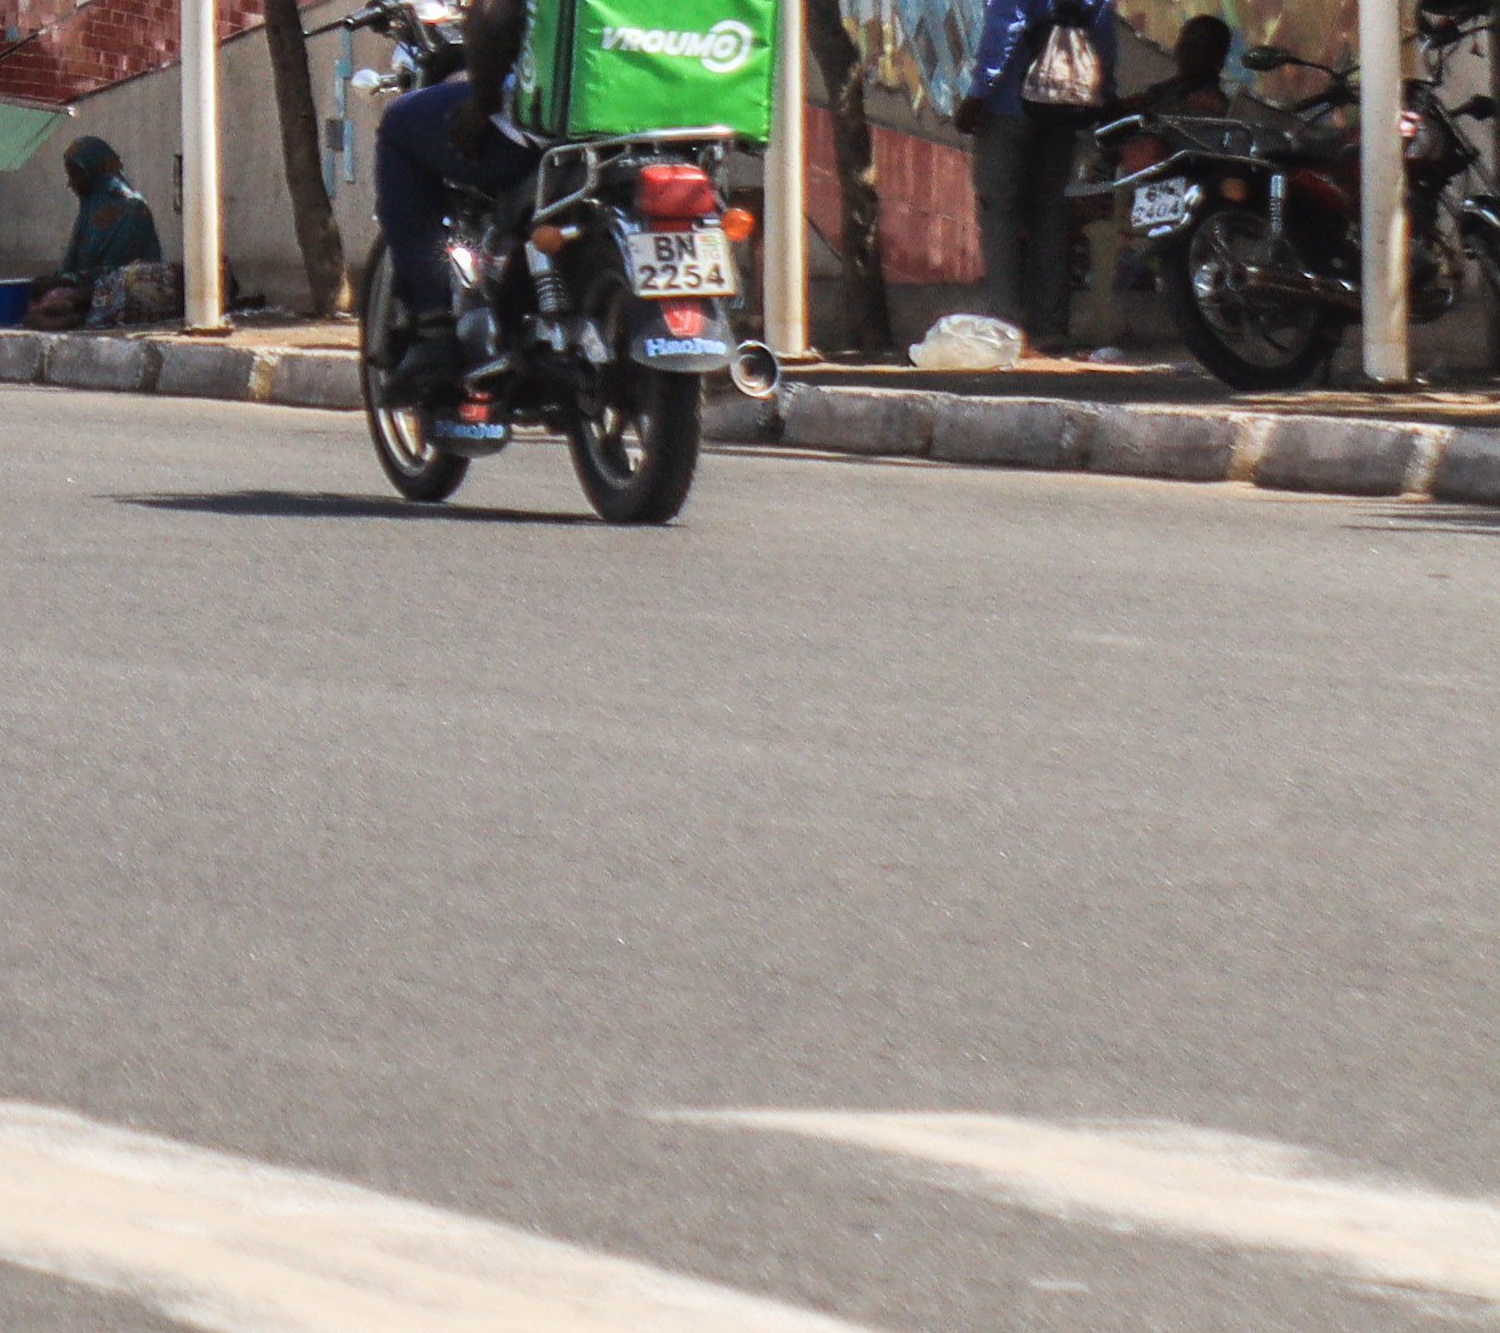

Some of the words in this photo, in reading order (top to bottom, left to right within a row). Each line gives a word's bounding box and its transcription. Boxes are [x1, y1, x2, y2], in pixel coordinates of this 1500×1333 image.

[602, 21, 752, 69] VROUMO
[653, 234, 697, 261] BN
[638, 263, 726, 290] 2254
